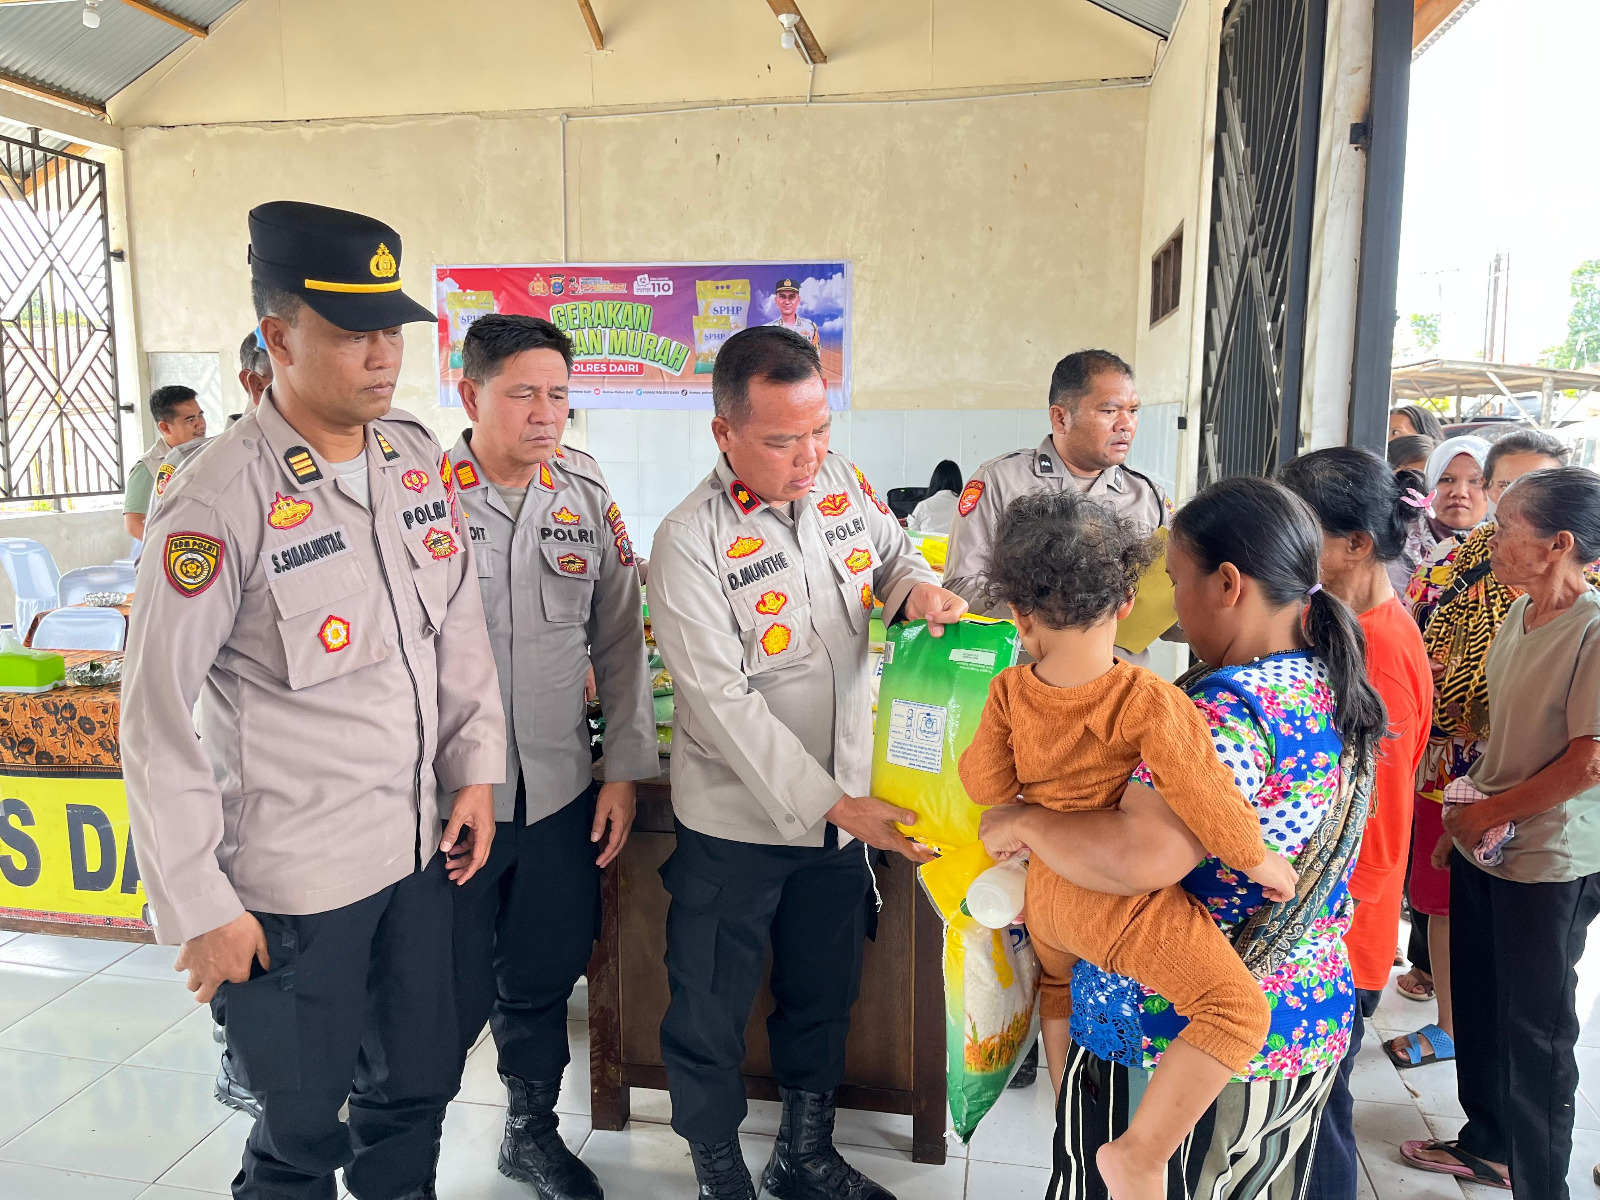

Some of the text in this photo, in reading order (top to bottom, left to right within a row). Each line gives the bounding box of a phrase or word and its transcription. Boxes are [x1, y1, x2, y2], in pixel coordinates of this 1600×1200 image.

[651, 282, 671, 293] 110
[552, 302, 651, 332] GERAKAN
[712, 306, 743, 316] SPHP
[704, 333, 726, 341] SPHP
[608, 329, 691, 372] MURAH
[572, 363, 639, 373] OLRES DAIRI
[402, 500, 447, 530] POLRI
[540, 527, 594, 545] POLRI
[825, 516, 866, 547] POLRI
[727, 551, 789, 591] D.MUNTHE
